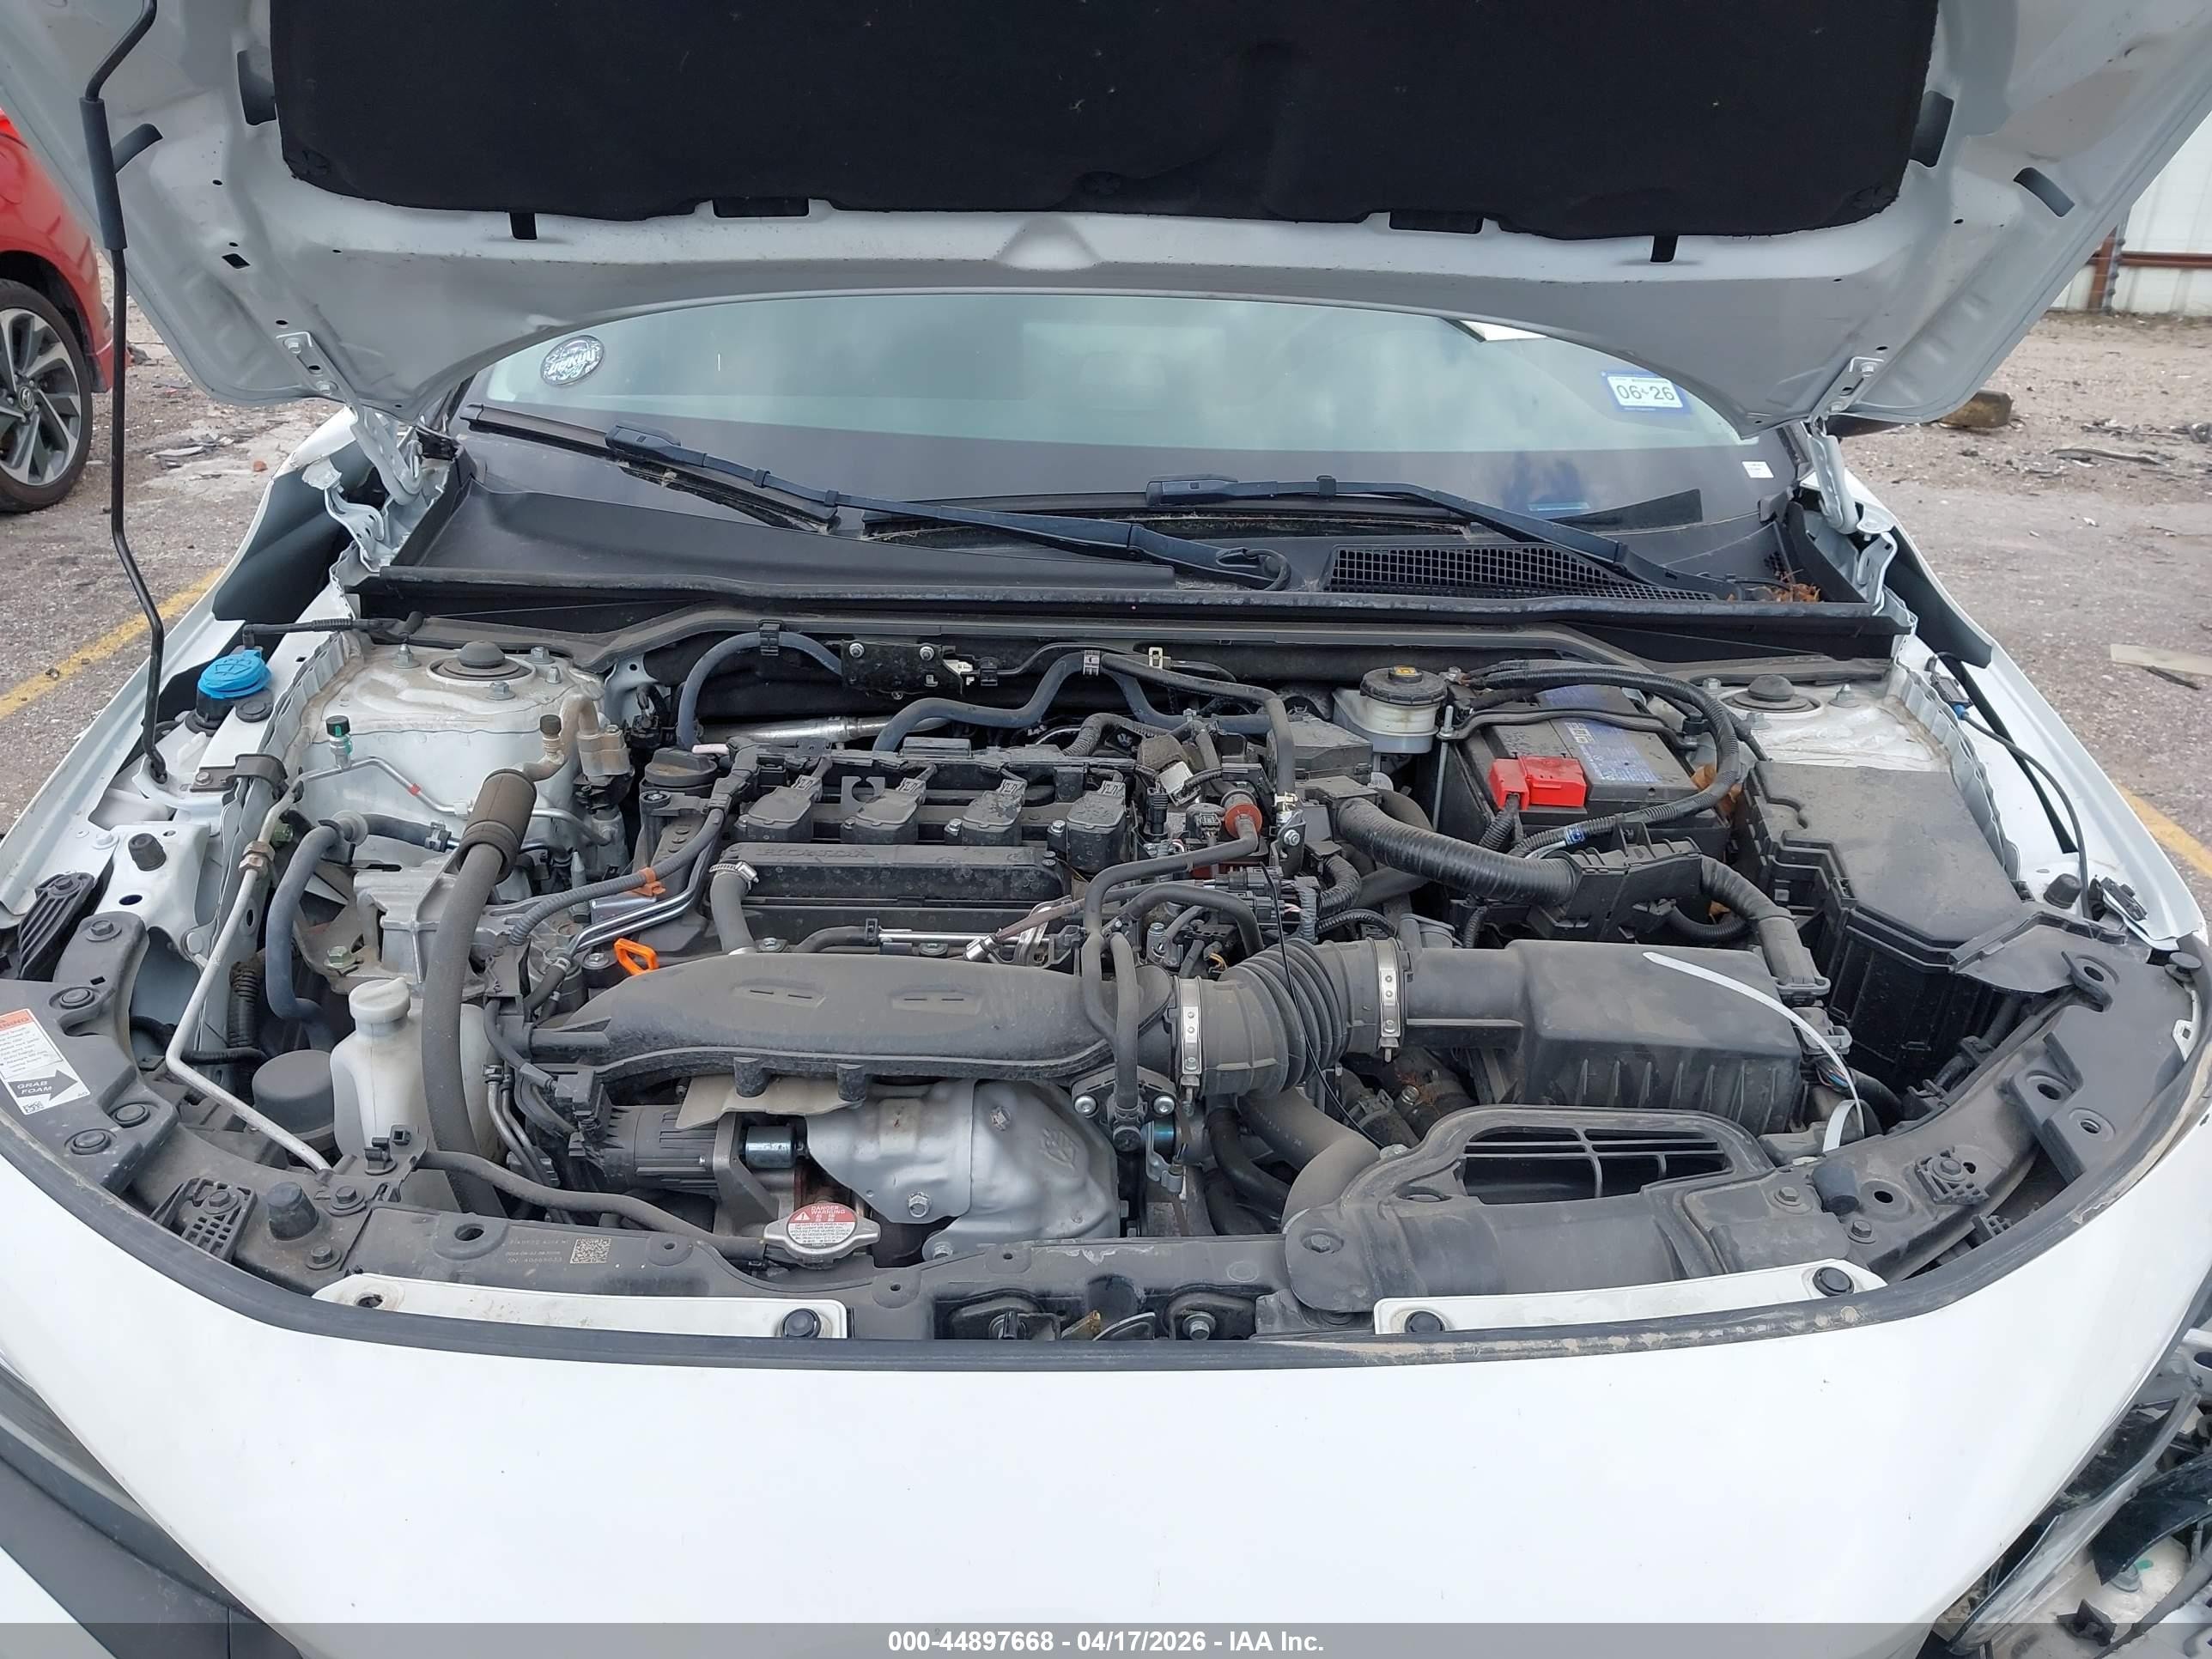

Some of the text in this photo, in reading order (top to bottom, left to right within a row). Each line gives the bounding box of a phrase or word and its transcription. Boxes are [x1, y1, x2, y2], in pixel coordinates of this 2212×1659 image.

[1616, 385, 1675, 401] 06 26
[17, 1080, 47, 1090] GRAB
[21, 1085, 52, 1095] FOAM
